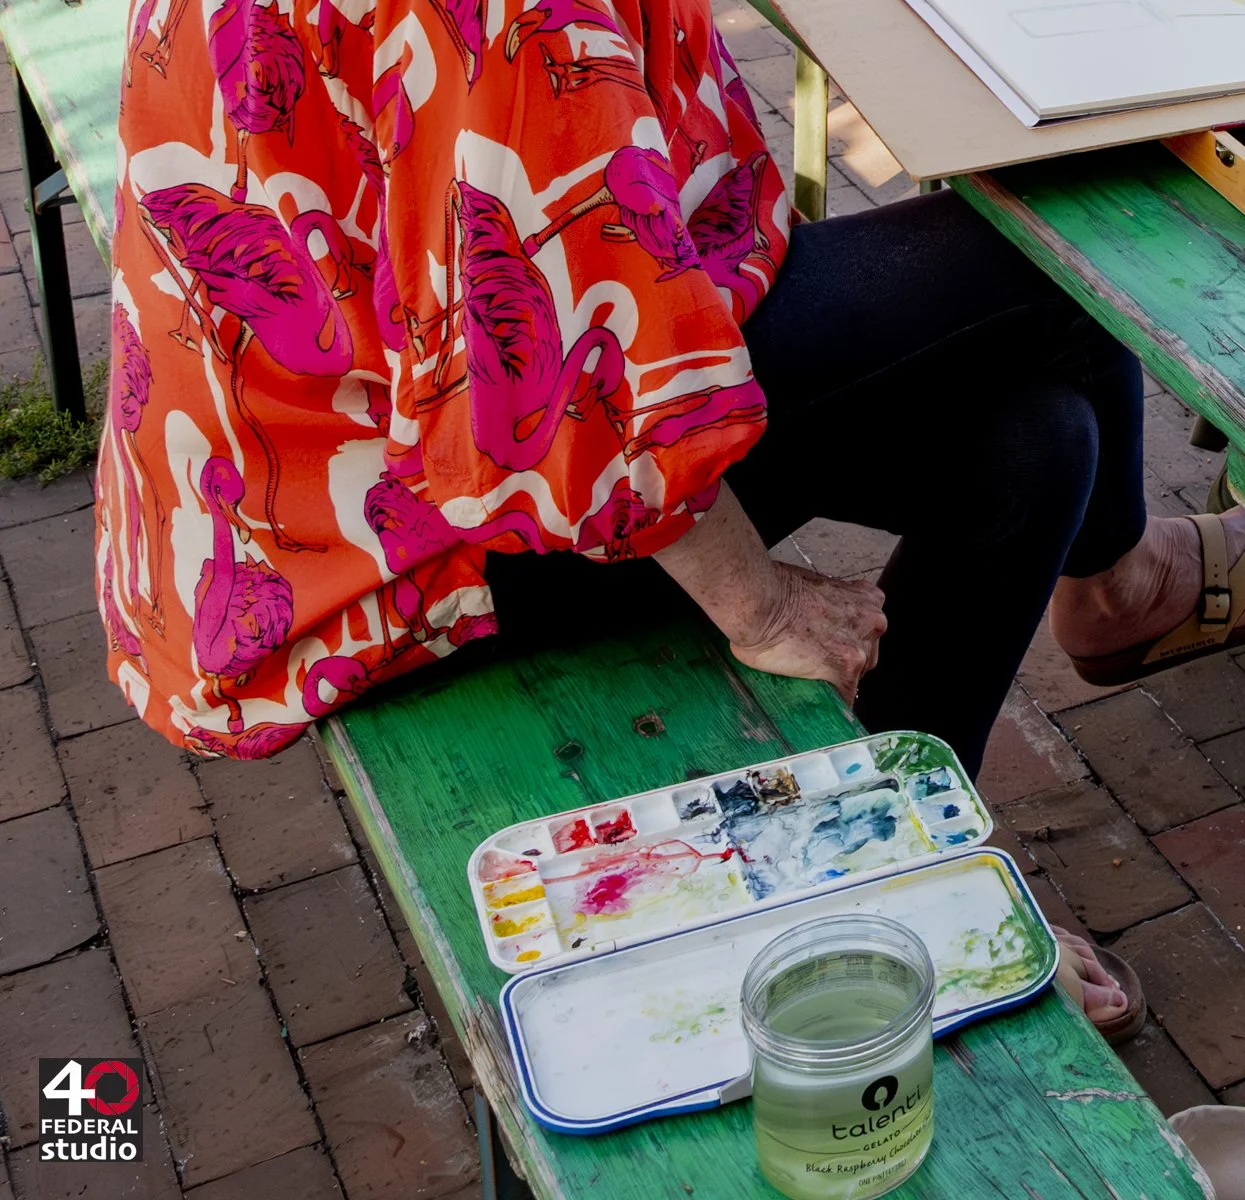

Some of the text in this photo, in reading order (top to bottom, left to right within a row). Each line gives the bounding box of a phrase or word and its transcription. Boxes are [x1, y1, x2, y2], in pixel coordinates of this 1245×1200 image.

[832, 1085, 921, 1140] talenti
[863, 1129, 901, 1152] GELATO
[805, 1162, 833, 1174] Black
[837, 1155, 887, 1175] Raspberry
[858, 1177, 871, 1187] ONE
